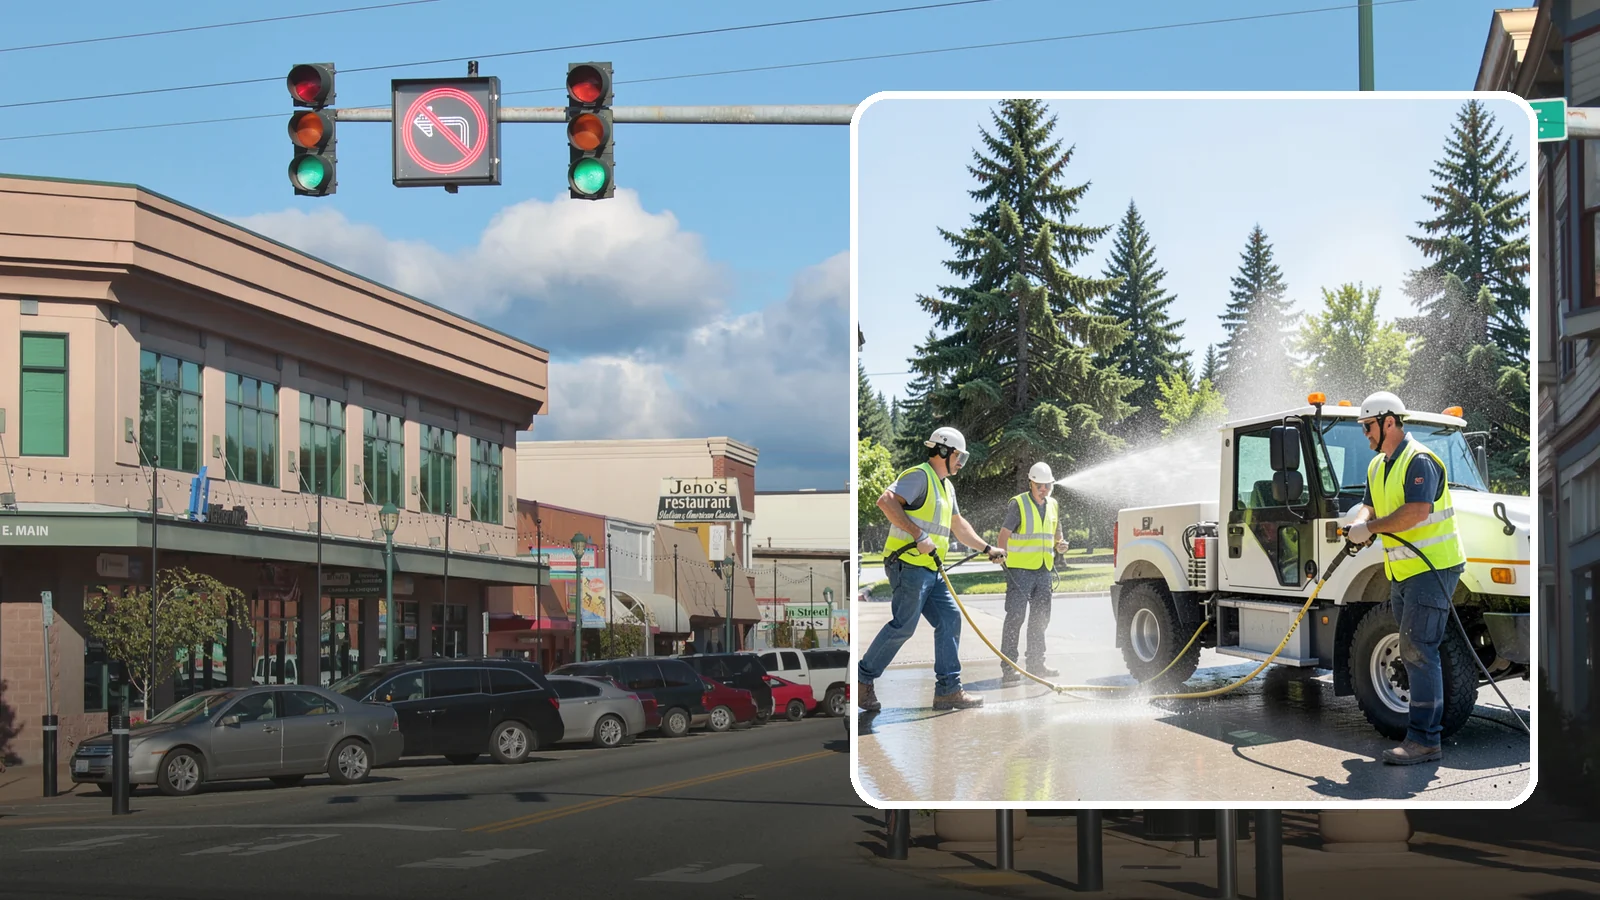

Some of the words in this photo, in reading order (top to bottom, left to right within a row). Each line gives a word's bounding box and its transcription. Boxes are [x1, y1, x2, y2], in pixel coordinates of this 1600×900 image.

[670, 480, 727, 495] Jeno's
[665, 496, 731, 509] restaurant
[659, 510, 682, 520] Italian
[686, 509, 714, 519] American
[715, 509, 738, 519] Cuisine
[2, 525, 13, 536] E.
[15, 525, 49, 536] MAIN
[797, 607, 828, 617] Street
[791, 619, 824, 627] lass
